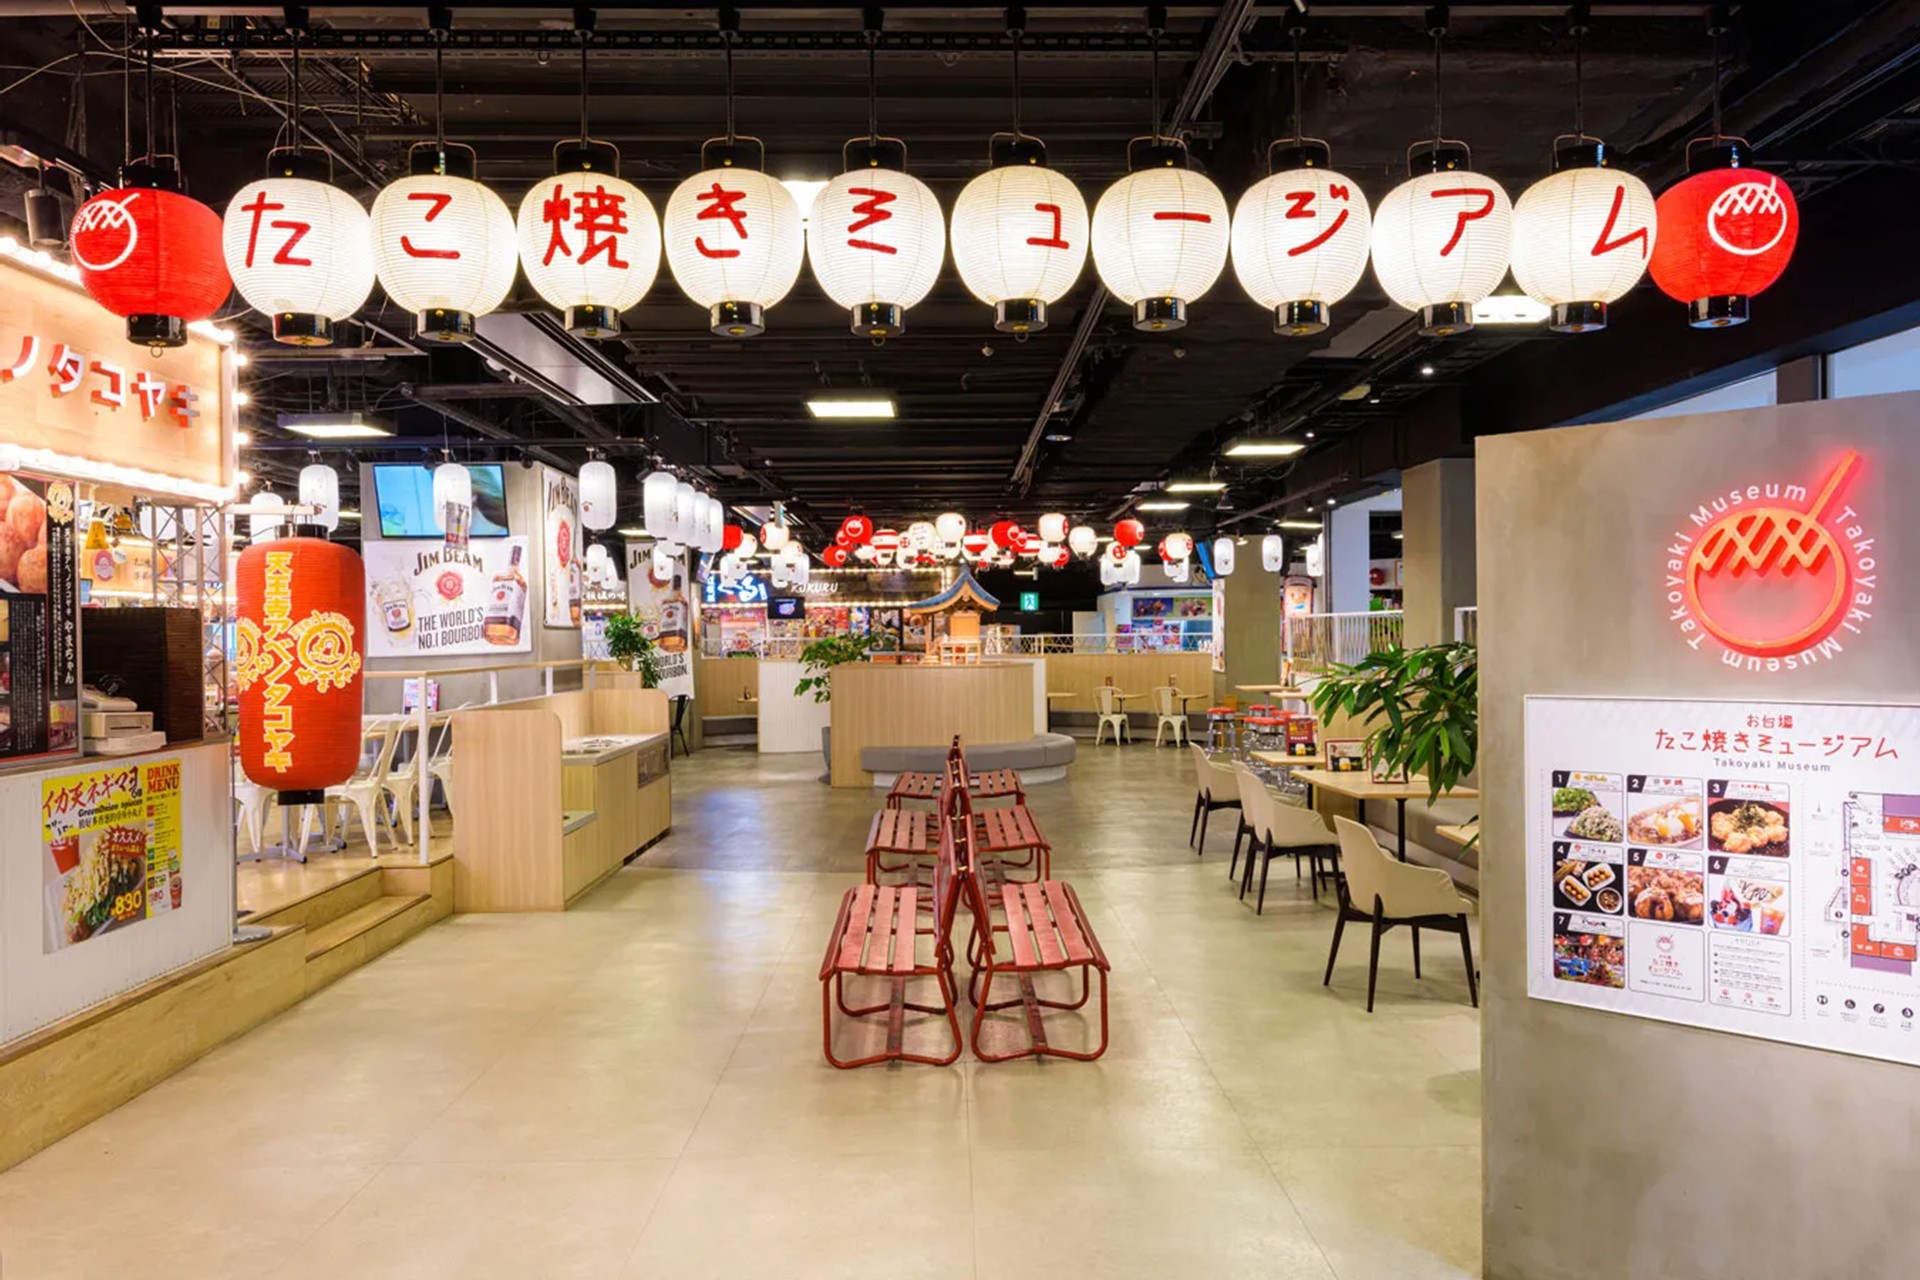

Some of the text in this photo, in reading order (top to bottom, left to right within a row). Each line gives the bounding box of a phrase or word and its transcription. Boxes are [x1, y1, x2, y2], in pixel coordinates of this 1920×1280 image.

[413, 544, 483, 576] JIM BEAM
[629, 548, 651, 569] JIM
[1666, 483, 1807, 650] Takoyaki Museum
[1721, 505, 1877, 672] Takoyaki Museum
[418, 607, 484, 632] THE WORLD'S
[1746, 714, 1794, 730] お台場
[1655, 728, 1899, 760] たこ焼きミュージアム
[147, 763, 180, 780] DRINK
[1714, 757, 1831, 773] Takoyaki Museum
[148, 776, 180, 793] MENU
[1557, 774, 1562, 782] 1
[1631, 779, 1640, 788] 2
[1712, 783, 1720, 792] 3
[1557, 845, 1565, 854] 4
[1633, 852, 1640, 861] 5
[1714, 859, 1721, 870] 6
[1558, 917, 1564, 926] 7
